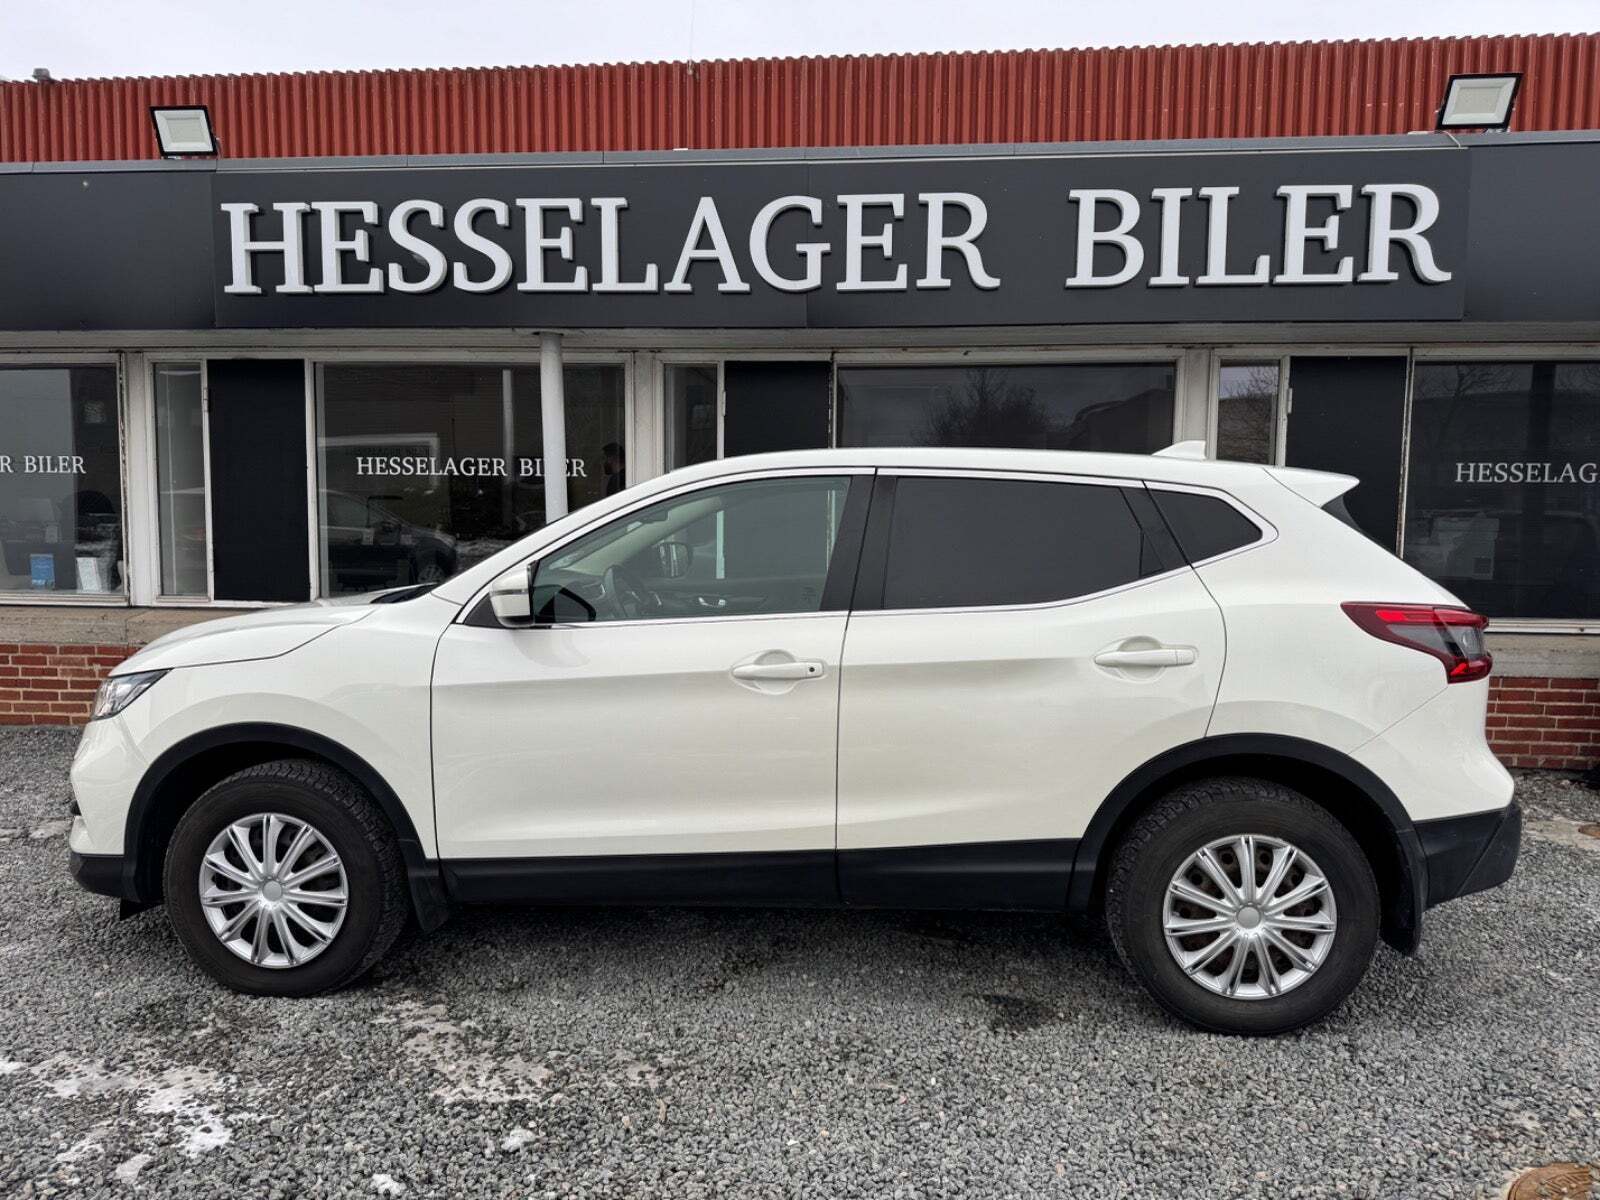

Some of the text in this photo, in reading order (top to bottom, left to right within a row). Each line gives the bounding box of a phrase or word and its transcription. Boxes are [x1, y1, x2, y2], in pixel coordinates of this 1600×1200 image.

[220, 183, 1452, 295] HESSELAGER BILER
[24, 455, 87, 474] BILER
[356, 456, 588, 477] HESSELAGER BIR
[1455, 462, 1600, 484] HESSELAG
